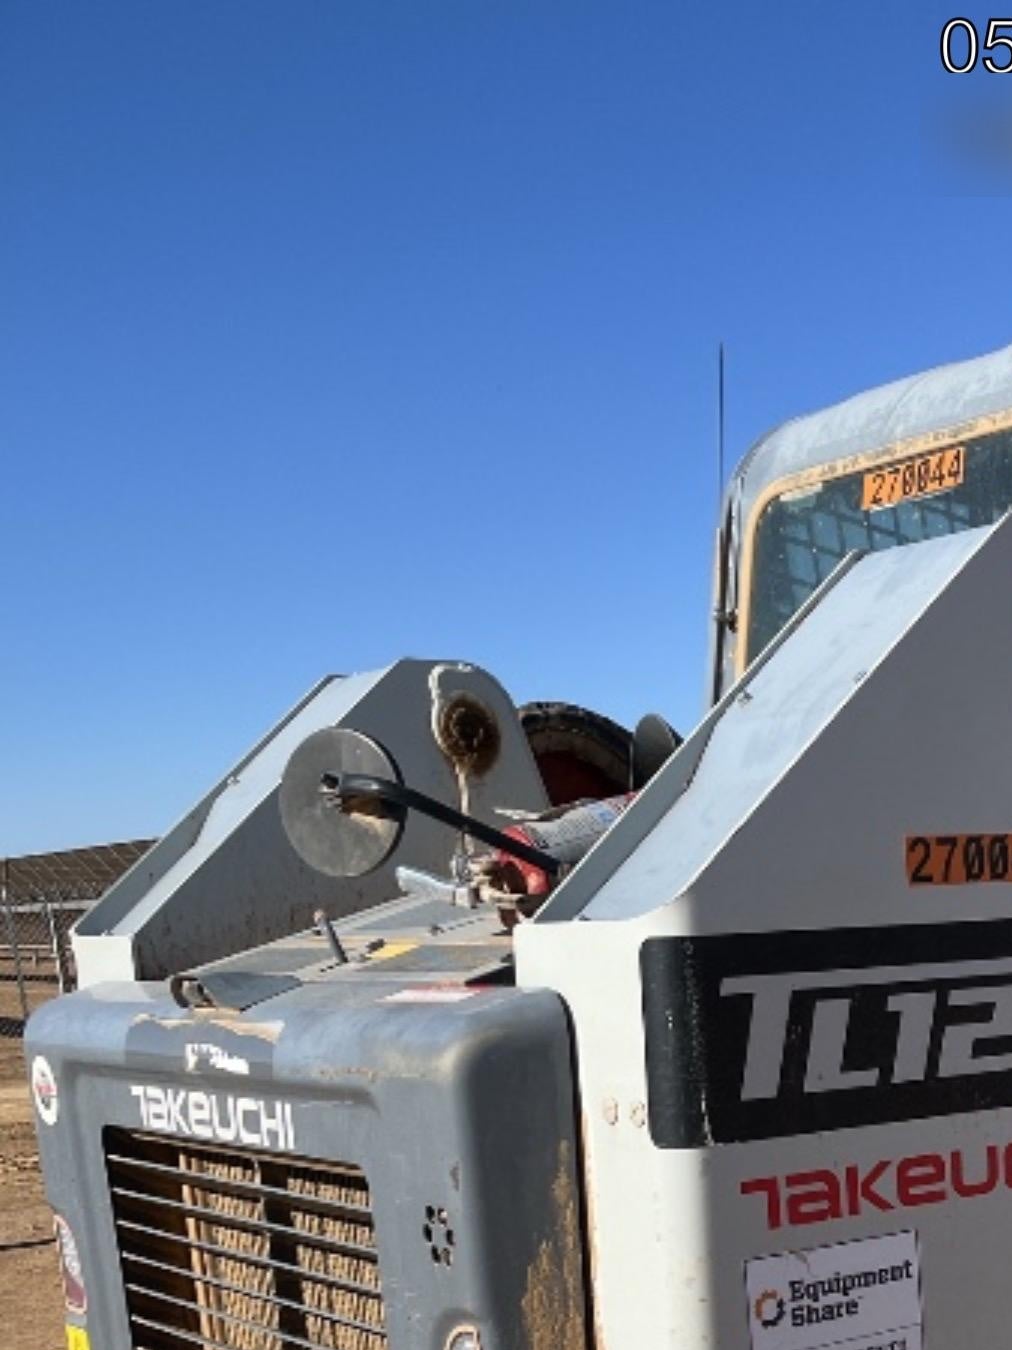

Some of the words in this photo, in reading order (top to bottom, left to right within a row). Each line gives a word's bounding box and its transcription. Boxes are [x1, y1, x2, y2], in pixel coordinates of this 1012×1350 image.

[870, 448, 961, 504] 270044
[788, 1259, 913, 1303] Equipment
[791, 1299, 859, 1327] Share
